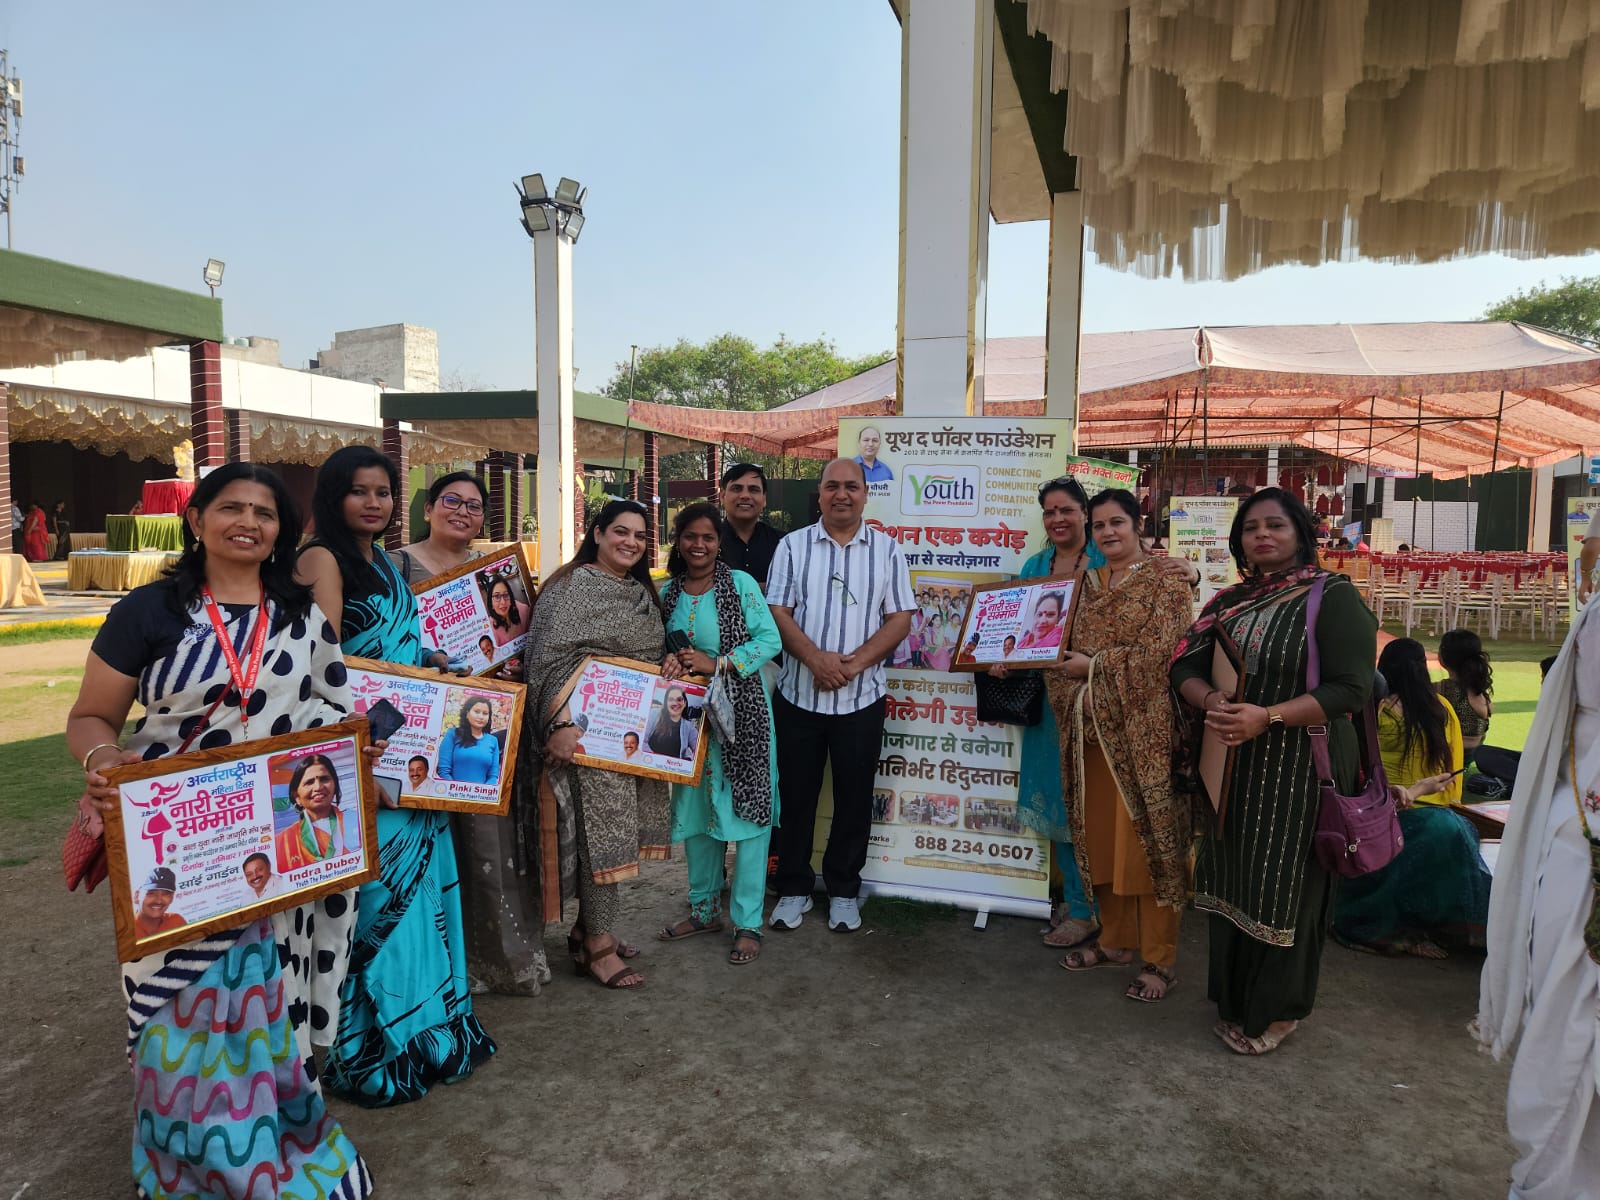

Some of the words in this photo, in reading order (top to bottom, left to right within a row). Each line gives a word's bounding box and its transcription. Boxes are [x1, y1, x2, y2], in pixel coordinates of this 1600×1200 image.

[885, 431, 914, 452] यूथ
[916, 431, 929, 447] द
[931, 426, 974, 447] पॉवर
[976, 427, 1056, 449] फाउंडेशन
[986, 467, 1041, 478] CONNECTING
[908, 474, 973, 505] Youth
[985, 480, 1038, 491] COMMUNITIE
[924, 526, 965, 547] एक
[968, 522, 1028, 554] करोड़
[921, 549, 935, 566] से
[433, 599, 454, 618] नारी
[440, 604, 477, 630] सम्मान
[597, 680, 620, 694] नारी
[402, 701, 432, 715] रत्न
[597, 692, 642, 711] सम्मान
[940, 732, 958, 752] से
[961, 735, 1014, 757] बनेगा
[939, 759, 1021, 791] हिंदुस्तान
[449, 783, 472, 793] Pinki
[474, 786, 498, 796] Singh
[169, 789, 211, 818] नारी
[214, 788, 254, 808] रत्न
[175, 803, 254, 838] सम्मान
[915, 834, 947, 851] 888
[951, 839, 984, 855] 234
[988, 843, 1034, 861] 0507
[206, 865, 239, 880] गार्डन
[289, 867, 321, 882] Indra
[325, 855, 360, 871] Dubey
